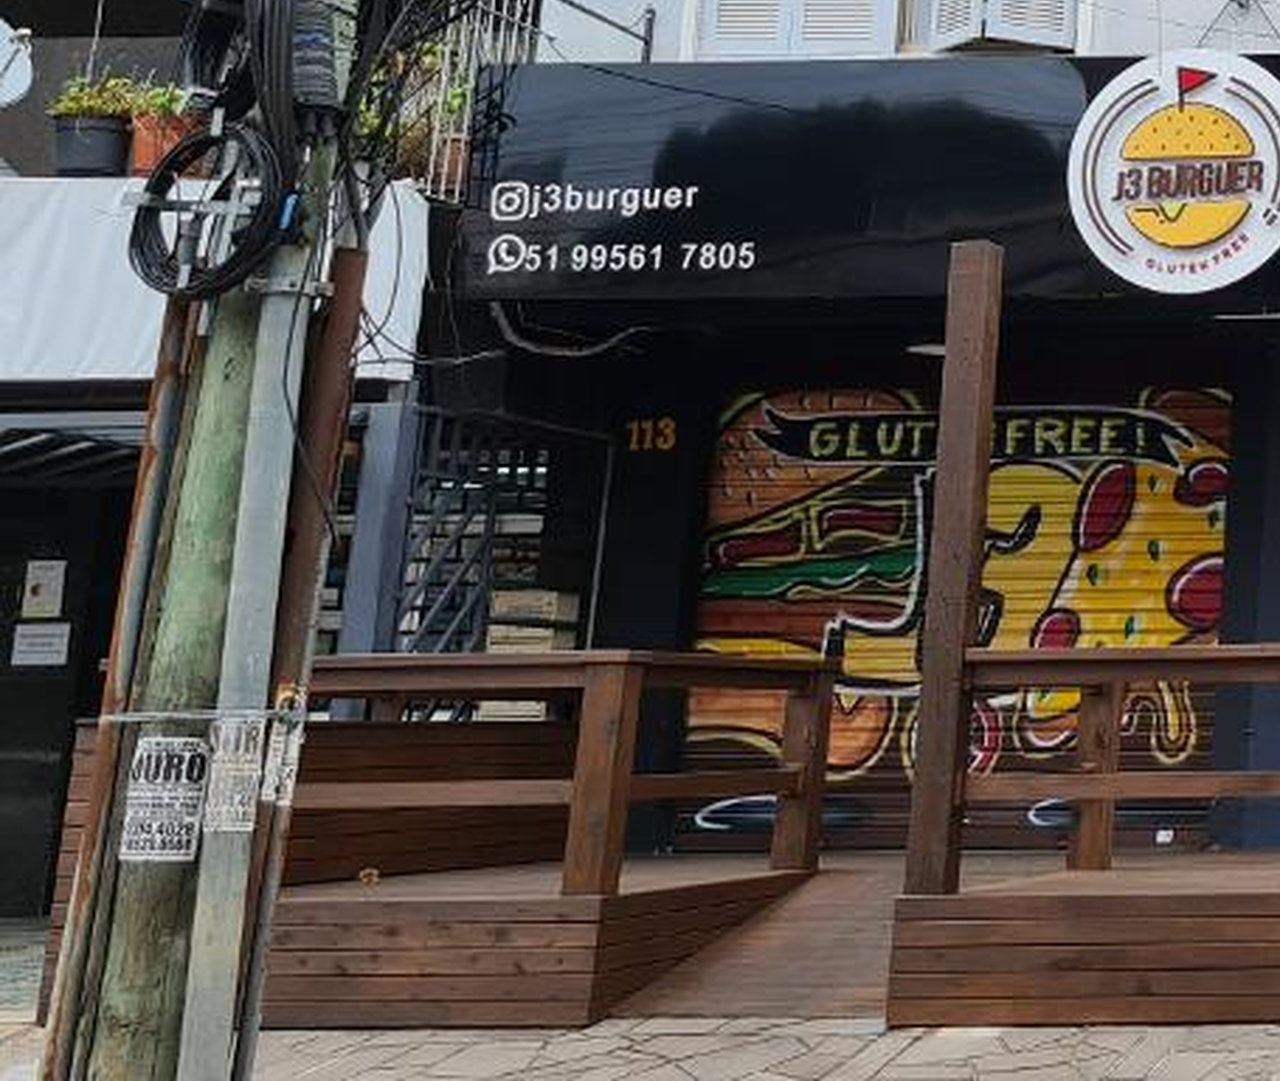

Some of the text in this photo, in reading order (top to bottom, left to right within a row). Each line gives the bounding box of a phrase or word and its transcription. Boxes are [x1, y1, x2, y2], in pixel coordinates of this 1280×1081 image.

[1145, 160, 1264, 199] BURGUER
[528, 184, 699, 218] j3burguer
[525, 241, 756, 270] 51 99561 7805
[627, 418, 677, 451] 113
